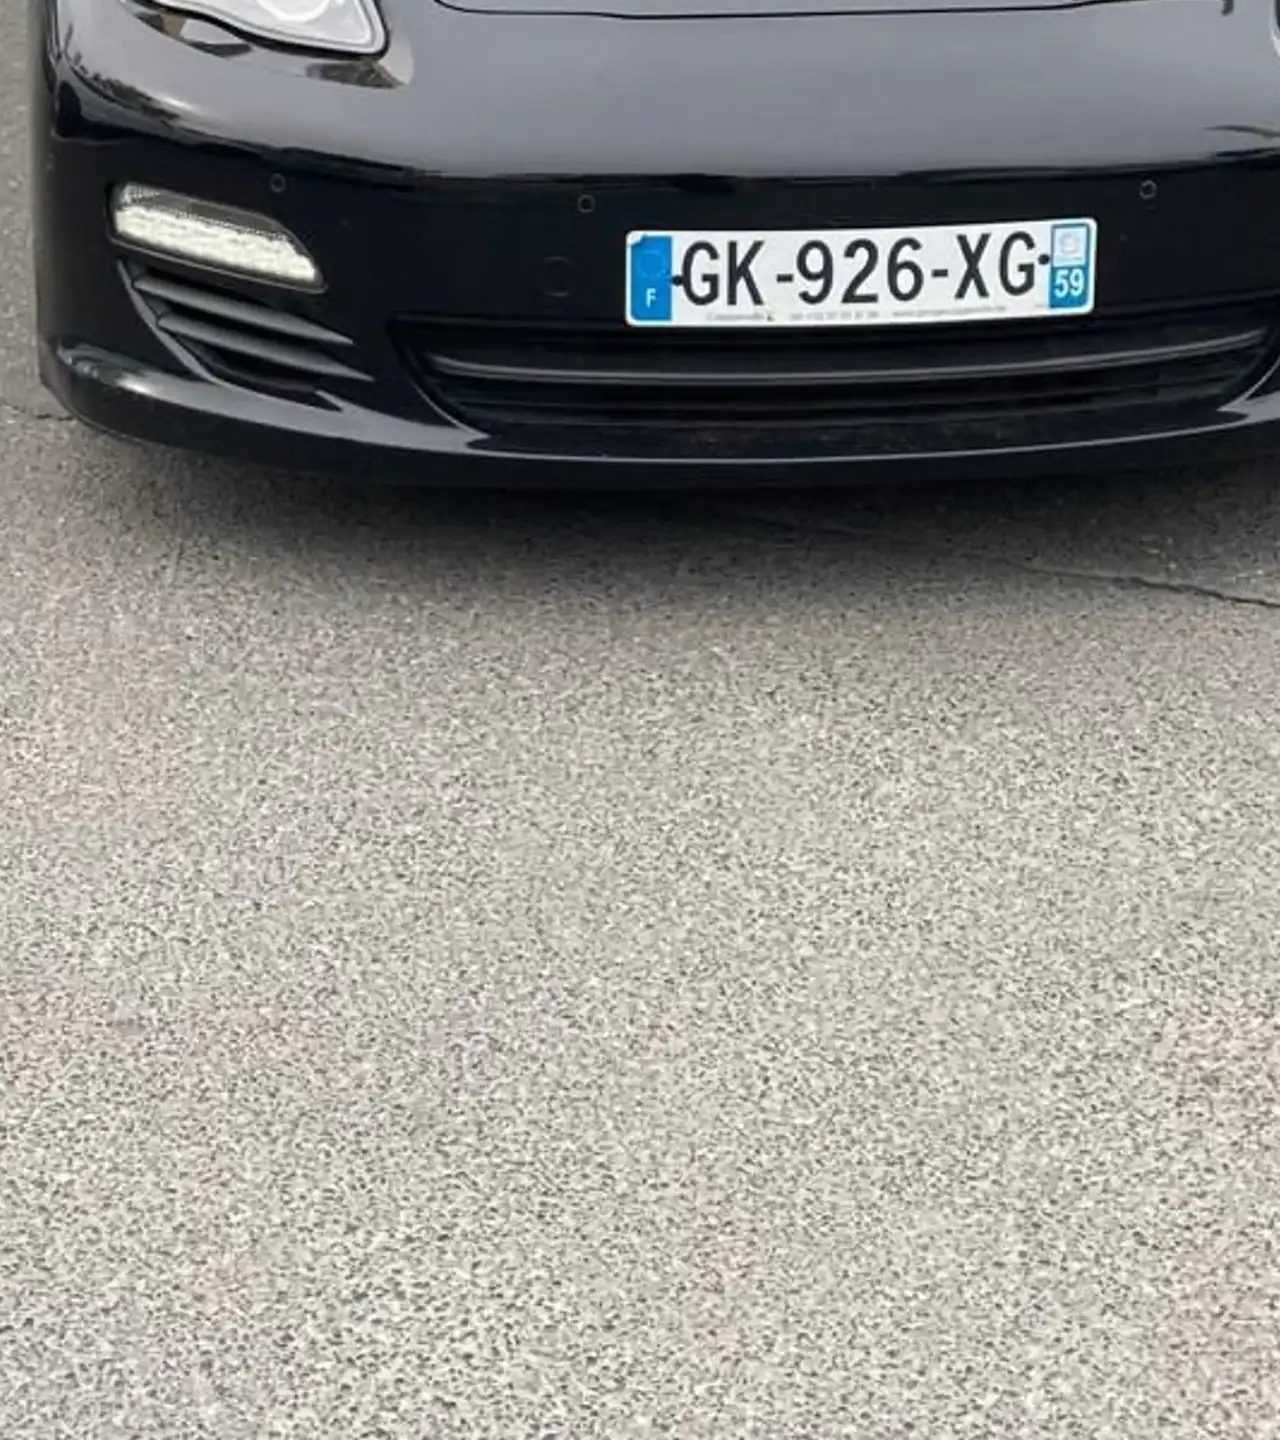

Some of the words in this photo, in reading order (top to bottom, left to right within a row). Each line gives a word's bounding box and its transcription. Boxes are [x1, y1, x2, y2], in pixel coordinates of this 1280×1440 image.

[681, 231, 1037, 306] GK-926-XG
[1053, 267, 1086, 298] 59
[645, 287, 658, 309] F
